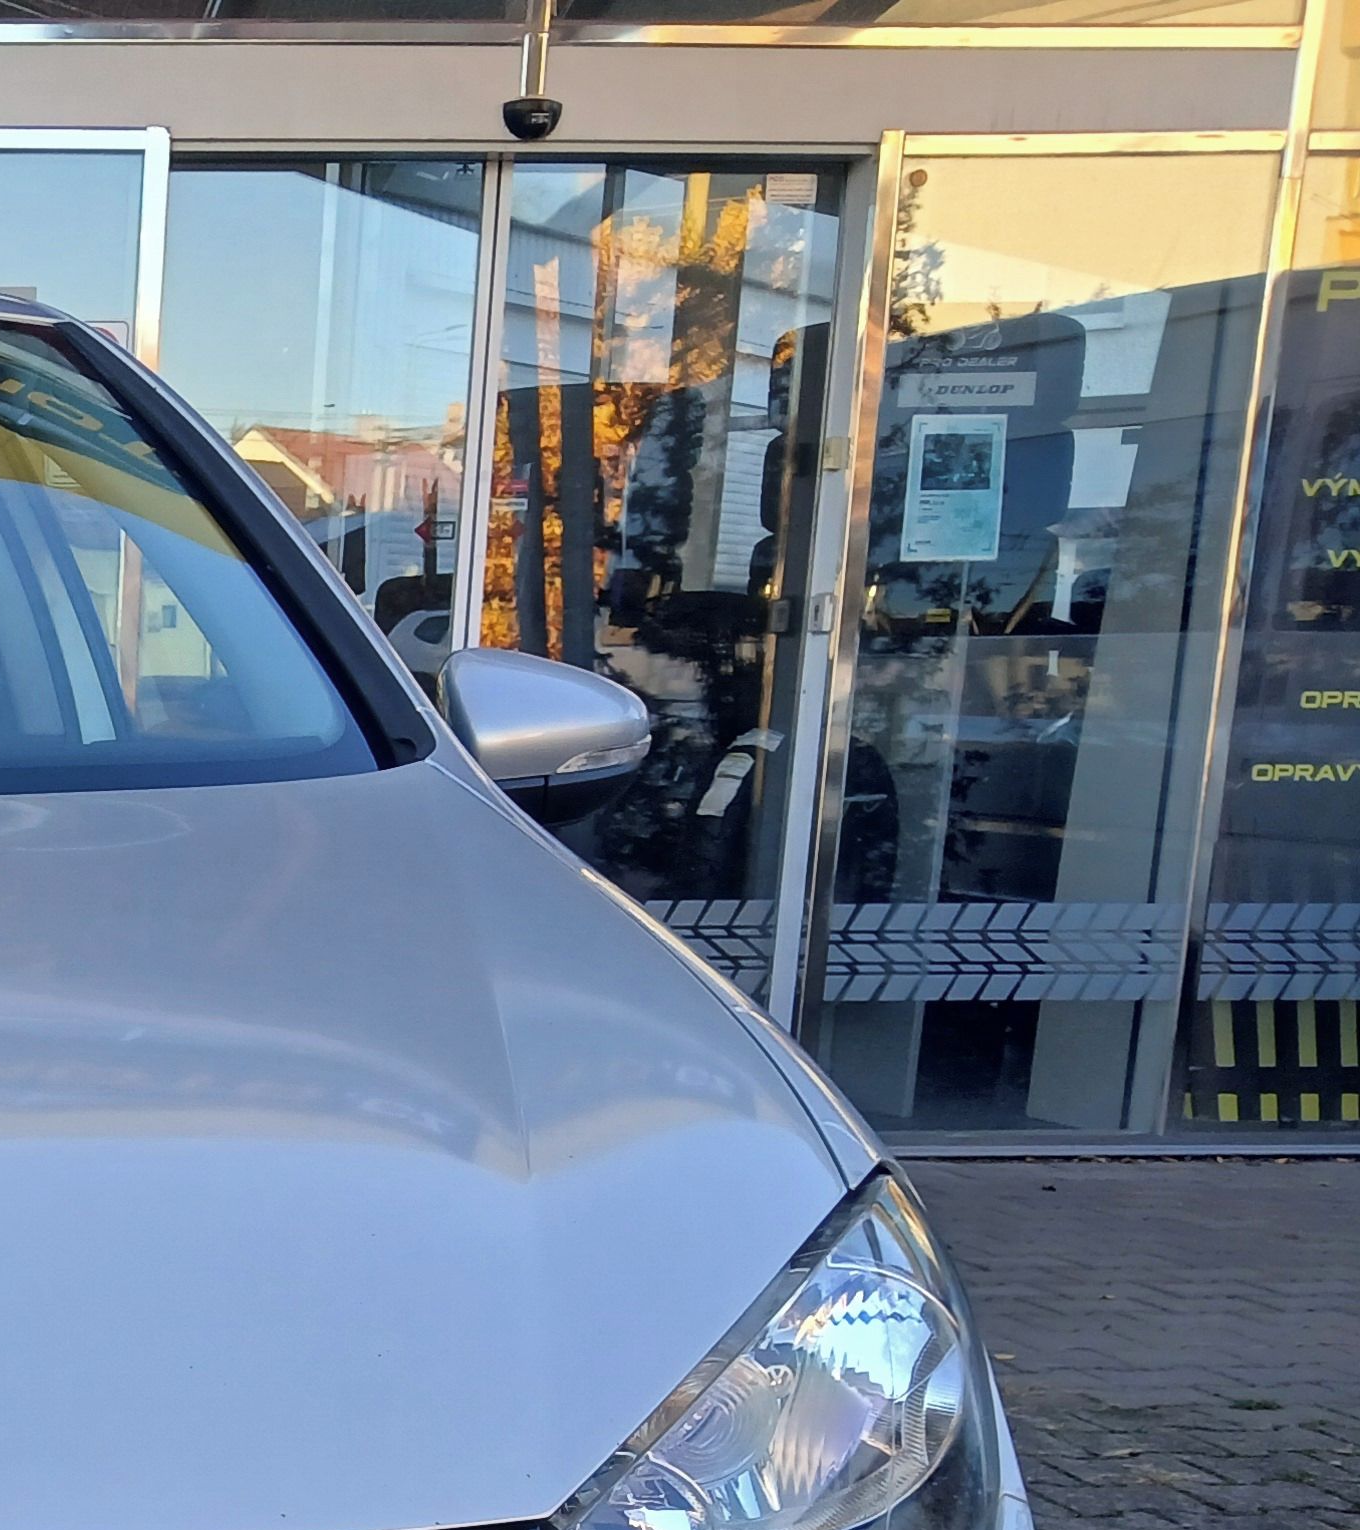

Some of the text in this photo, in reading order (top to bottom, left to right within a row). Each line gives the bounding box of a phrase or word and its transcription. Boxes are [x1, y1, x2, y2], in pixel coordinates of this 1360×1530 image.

[957, 356, 1019, 367] DEALER
[935, 383, 1016, 396] DUNLOP
[1251, 763, 1360, 782] OPRAV
